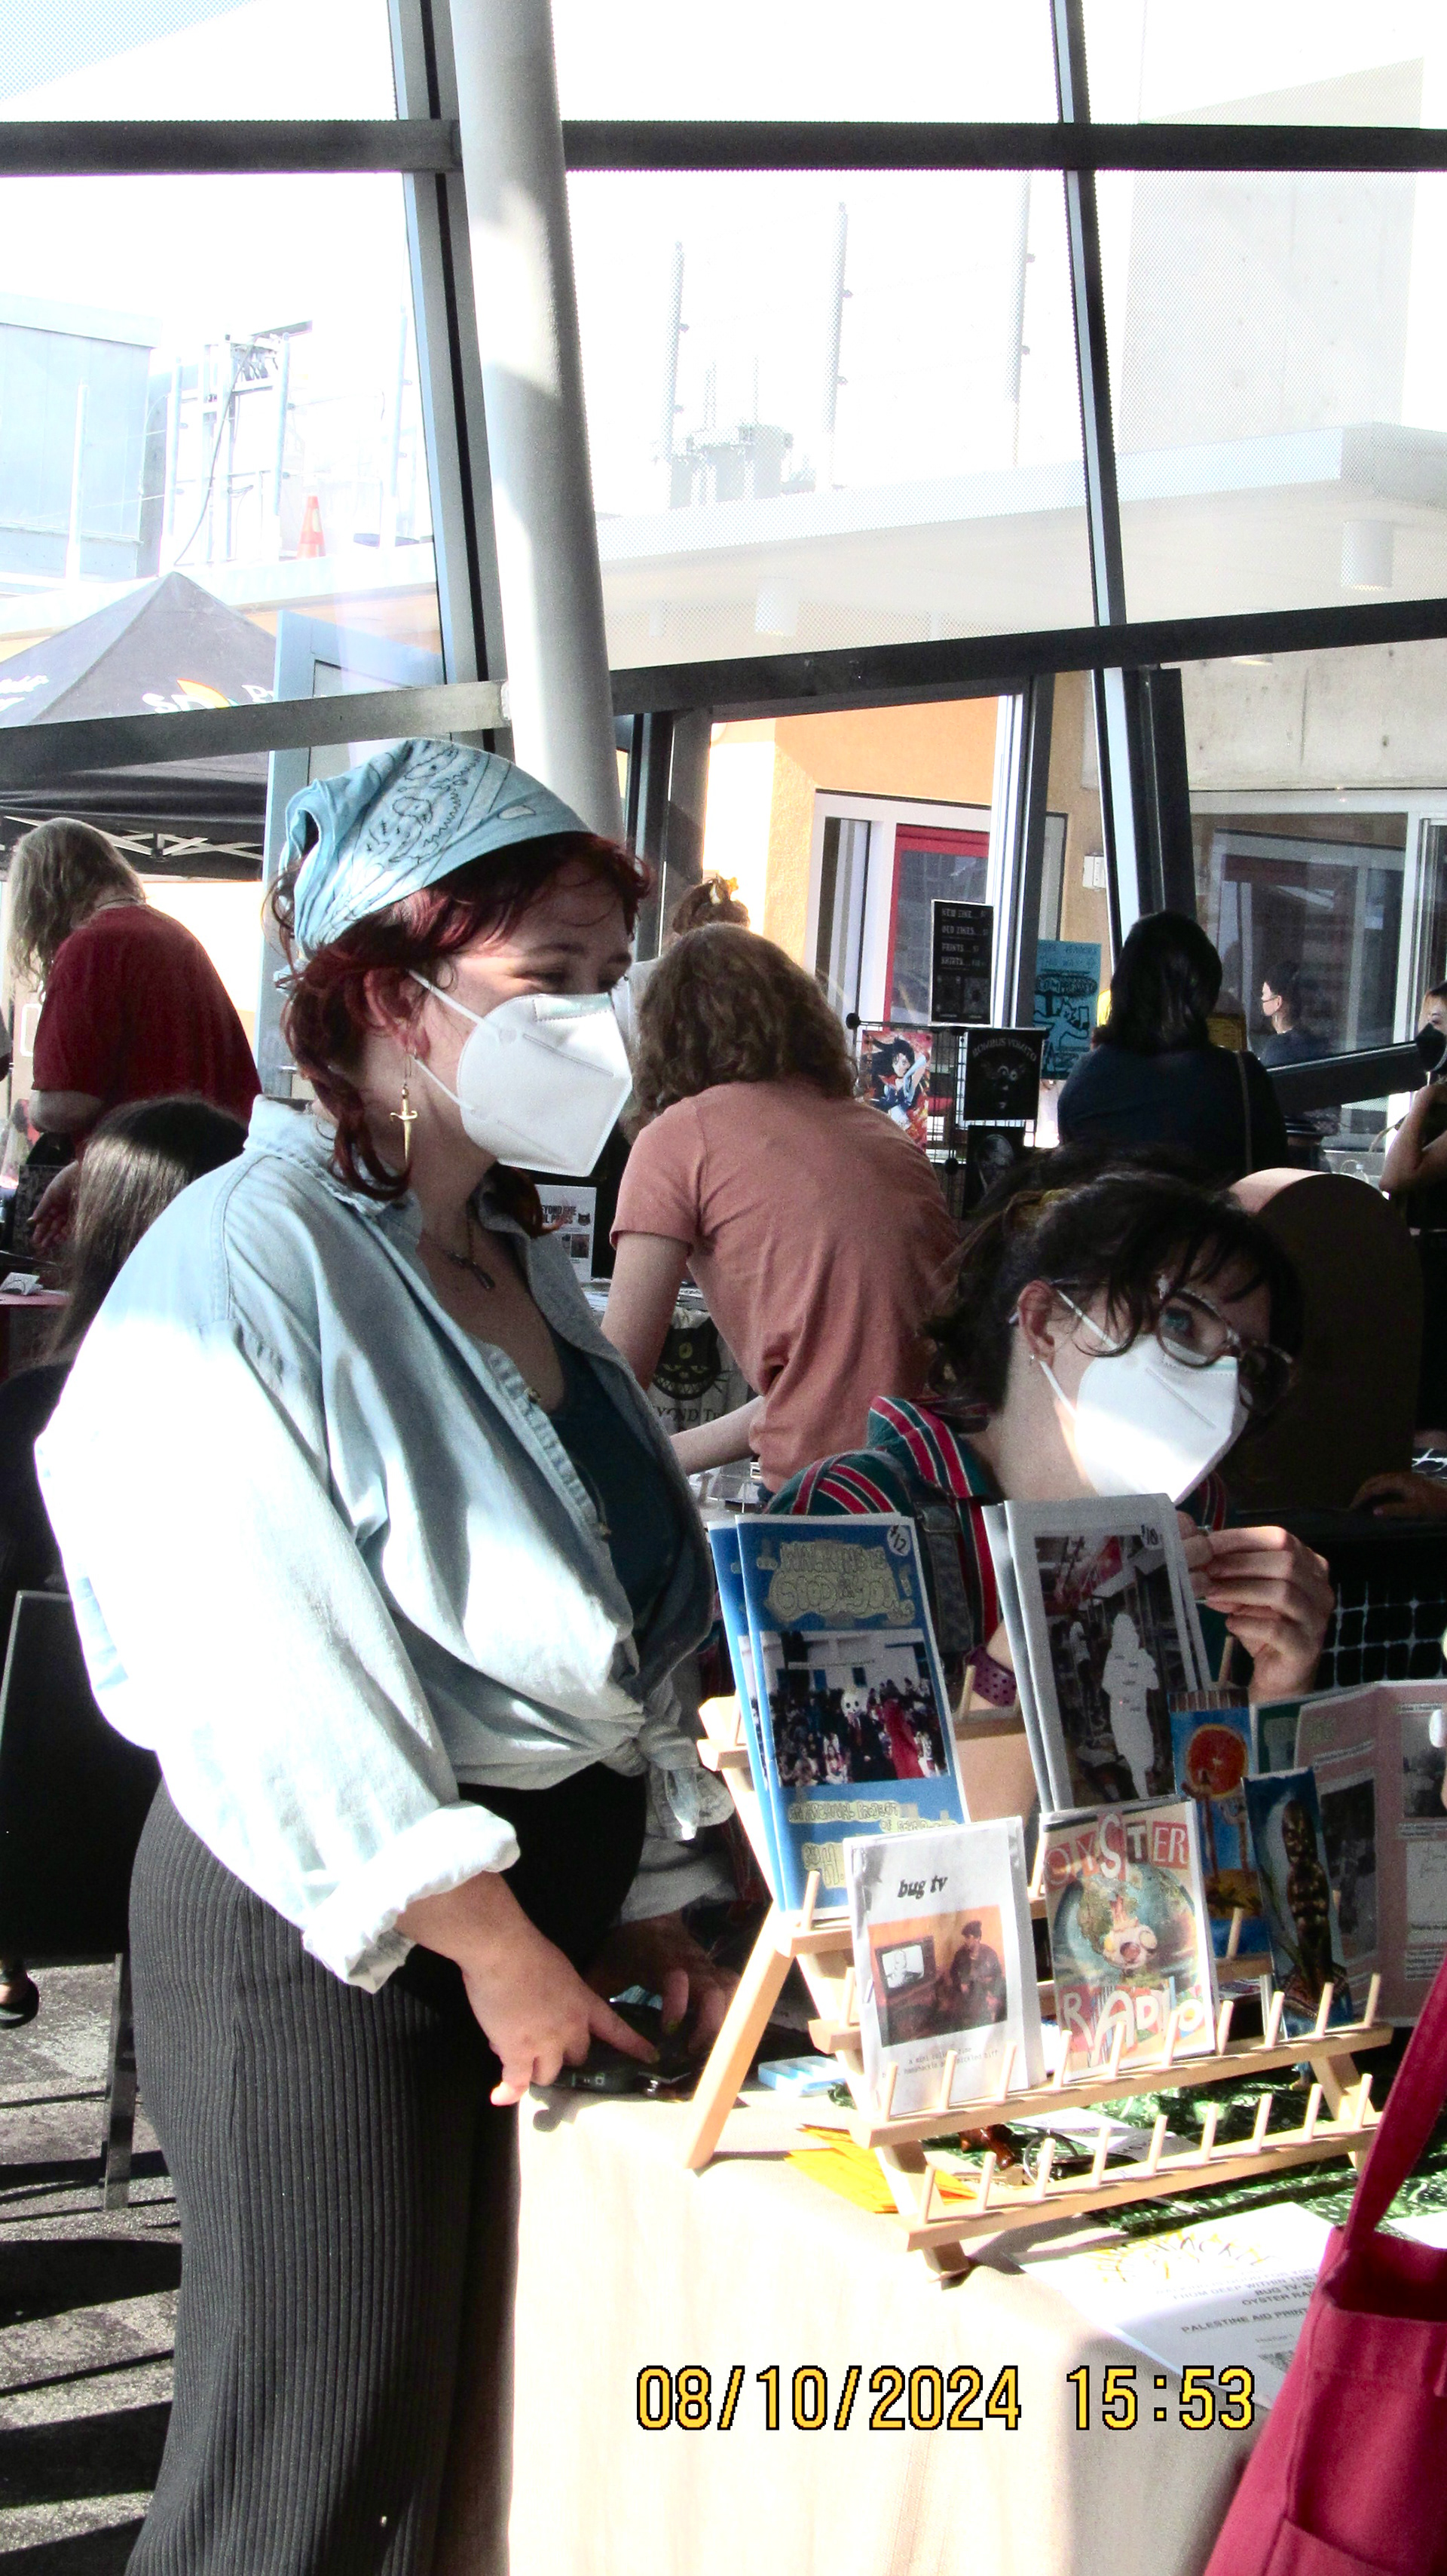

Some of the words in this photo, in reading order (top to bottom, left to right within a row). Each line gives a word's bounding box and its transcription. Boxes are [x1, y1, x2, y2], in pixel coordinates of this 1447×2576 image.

[889, 1525, 907, 1554] $12
[856, 1801, 899, 1819] PROJECT
[1044, 1812, 1188, 1885] OYSTER
[898, 1879, 926, 1899] bug
[929, 1873, 949, 1893] tv
[1063, 1990, 1204, 2069] RADIO
[1210, 2284, 1243, 2295] DEEP
[1245, 2277, 1287, 2290] WITHIN
[1254, 2287, 1282, 2296] BUG
[1241, 2293, 1290, 2306] OYSTER
[1180, 2315, 1250, 2333] PALESTINE
[1251, 2312, 1273, 2322] AID
